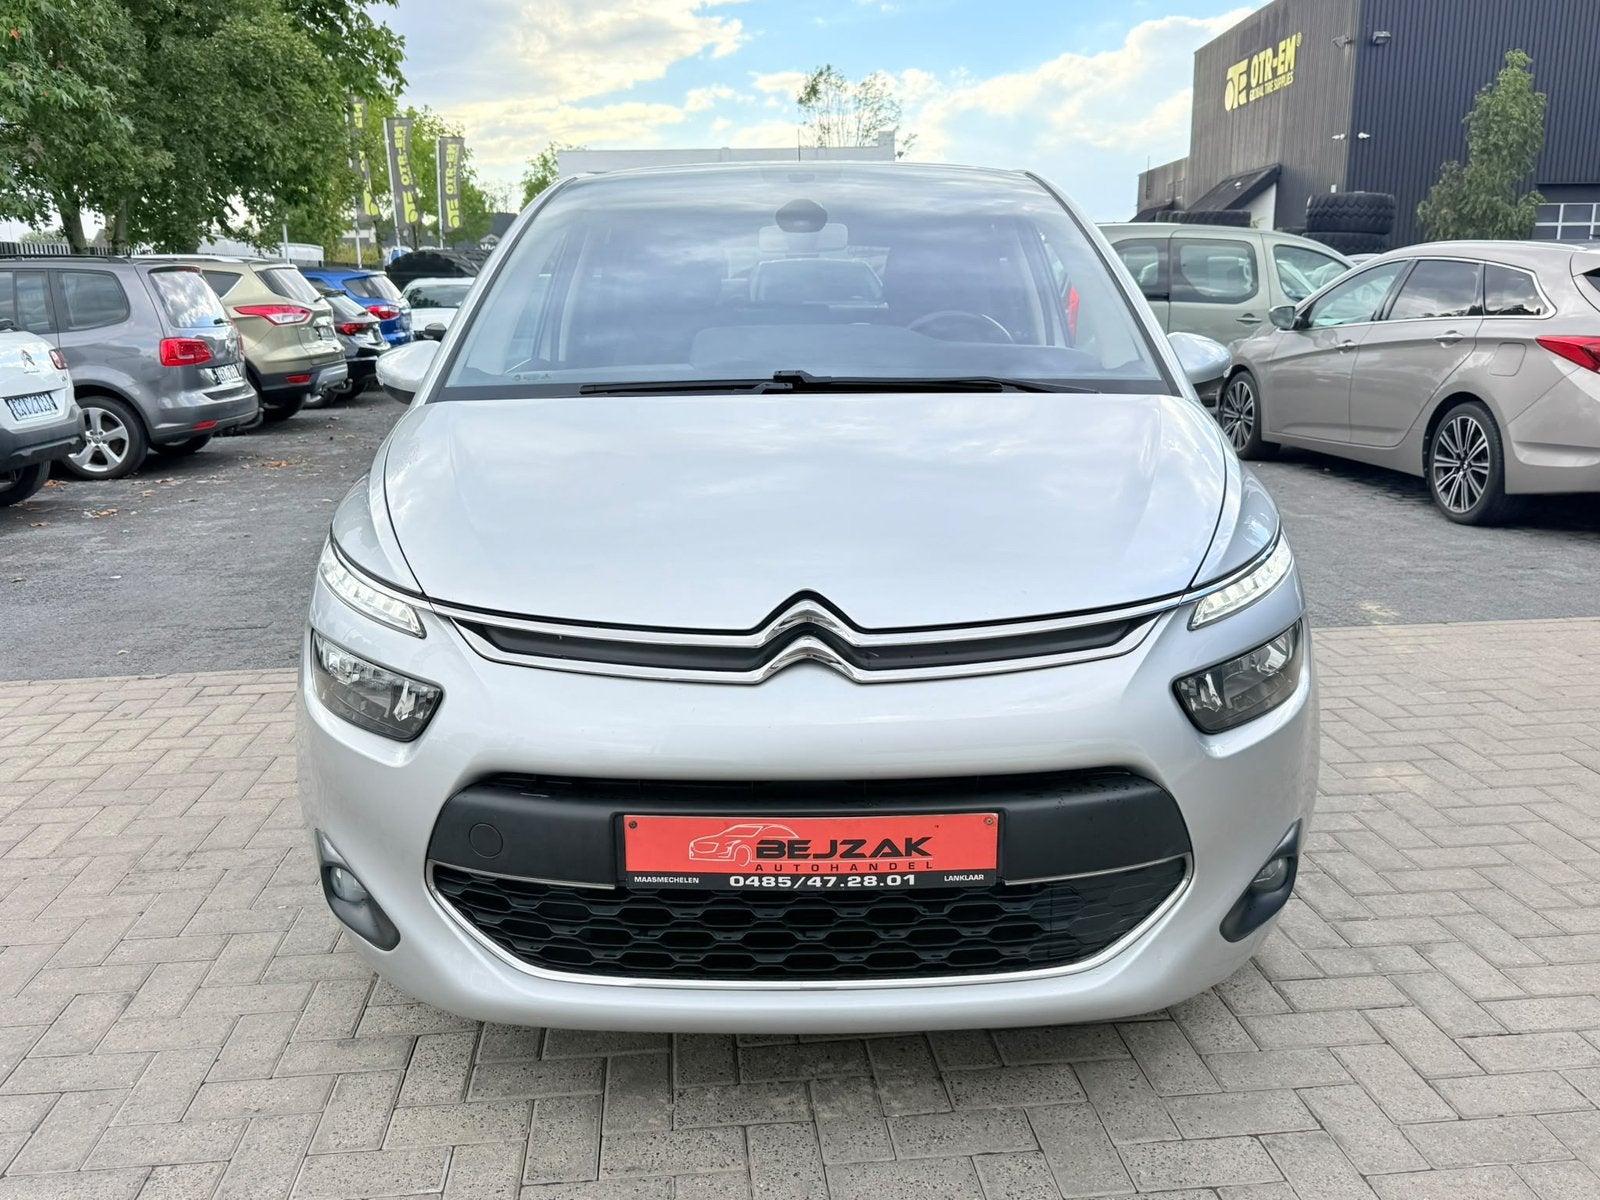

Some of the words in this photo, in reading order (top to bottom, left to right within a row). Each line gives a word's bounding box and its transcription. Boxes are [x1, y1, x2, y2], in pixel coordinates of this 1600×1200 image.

[394, 126, 410, 186] OTR-EM
[445, 144, 456, 195] OTR-EM
[756, 836, 933, 860] BEJZAK
[755, 861, 933, 872] AUTOHANDEL
[633, 876, 700, 884] MAASMECHELEN
[729, 874, 915, 889] 0485/47.28.01
[943, 874, 985, 882] LANKLAAR
